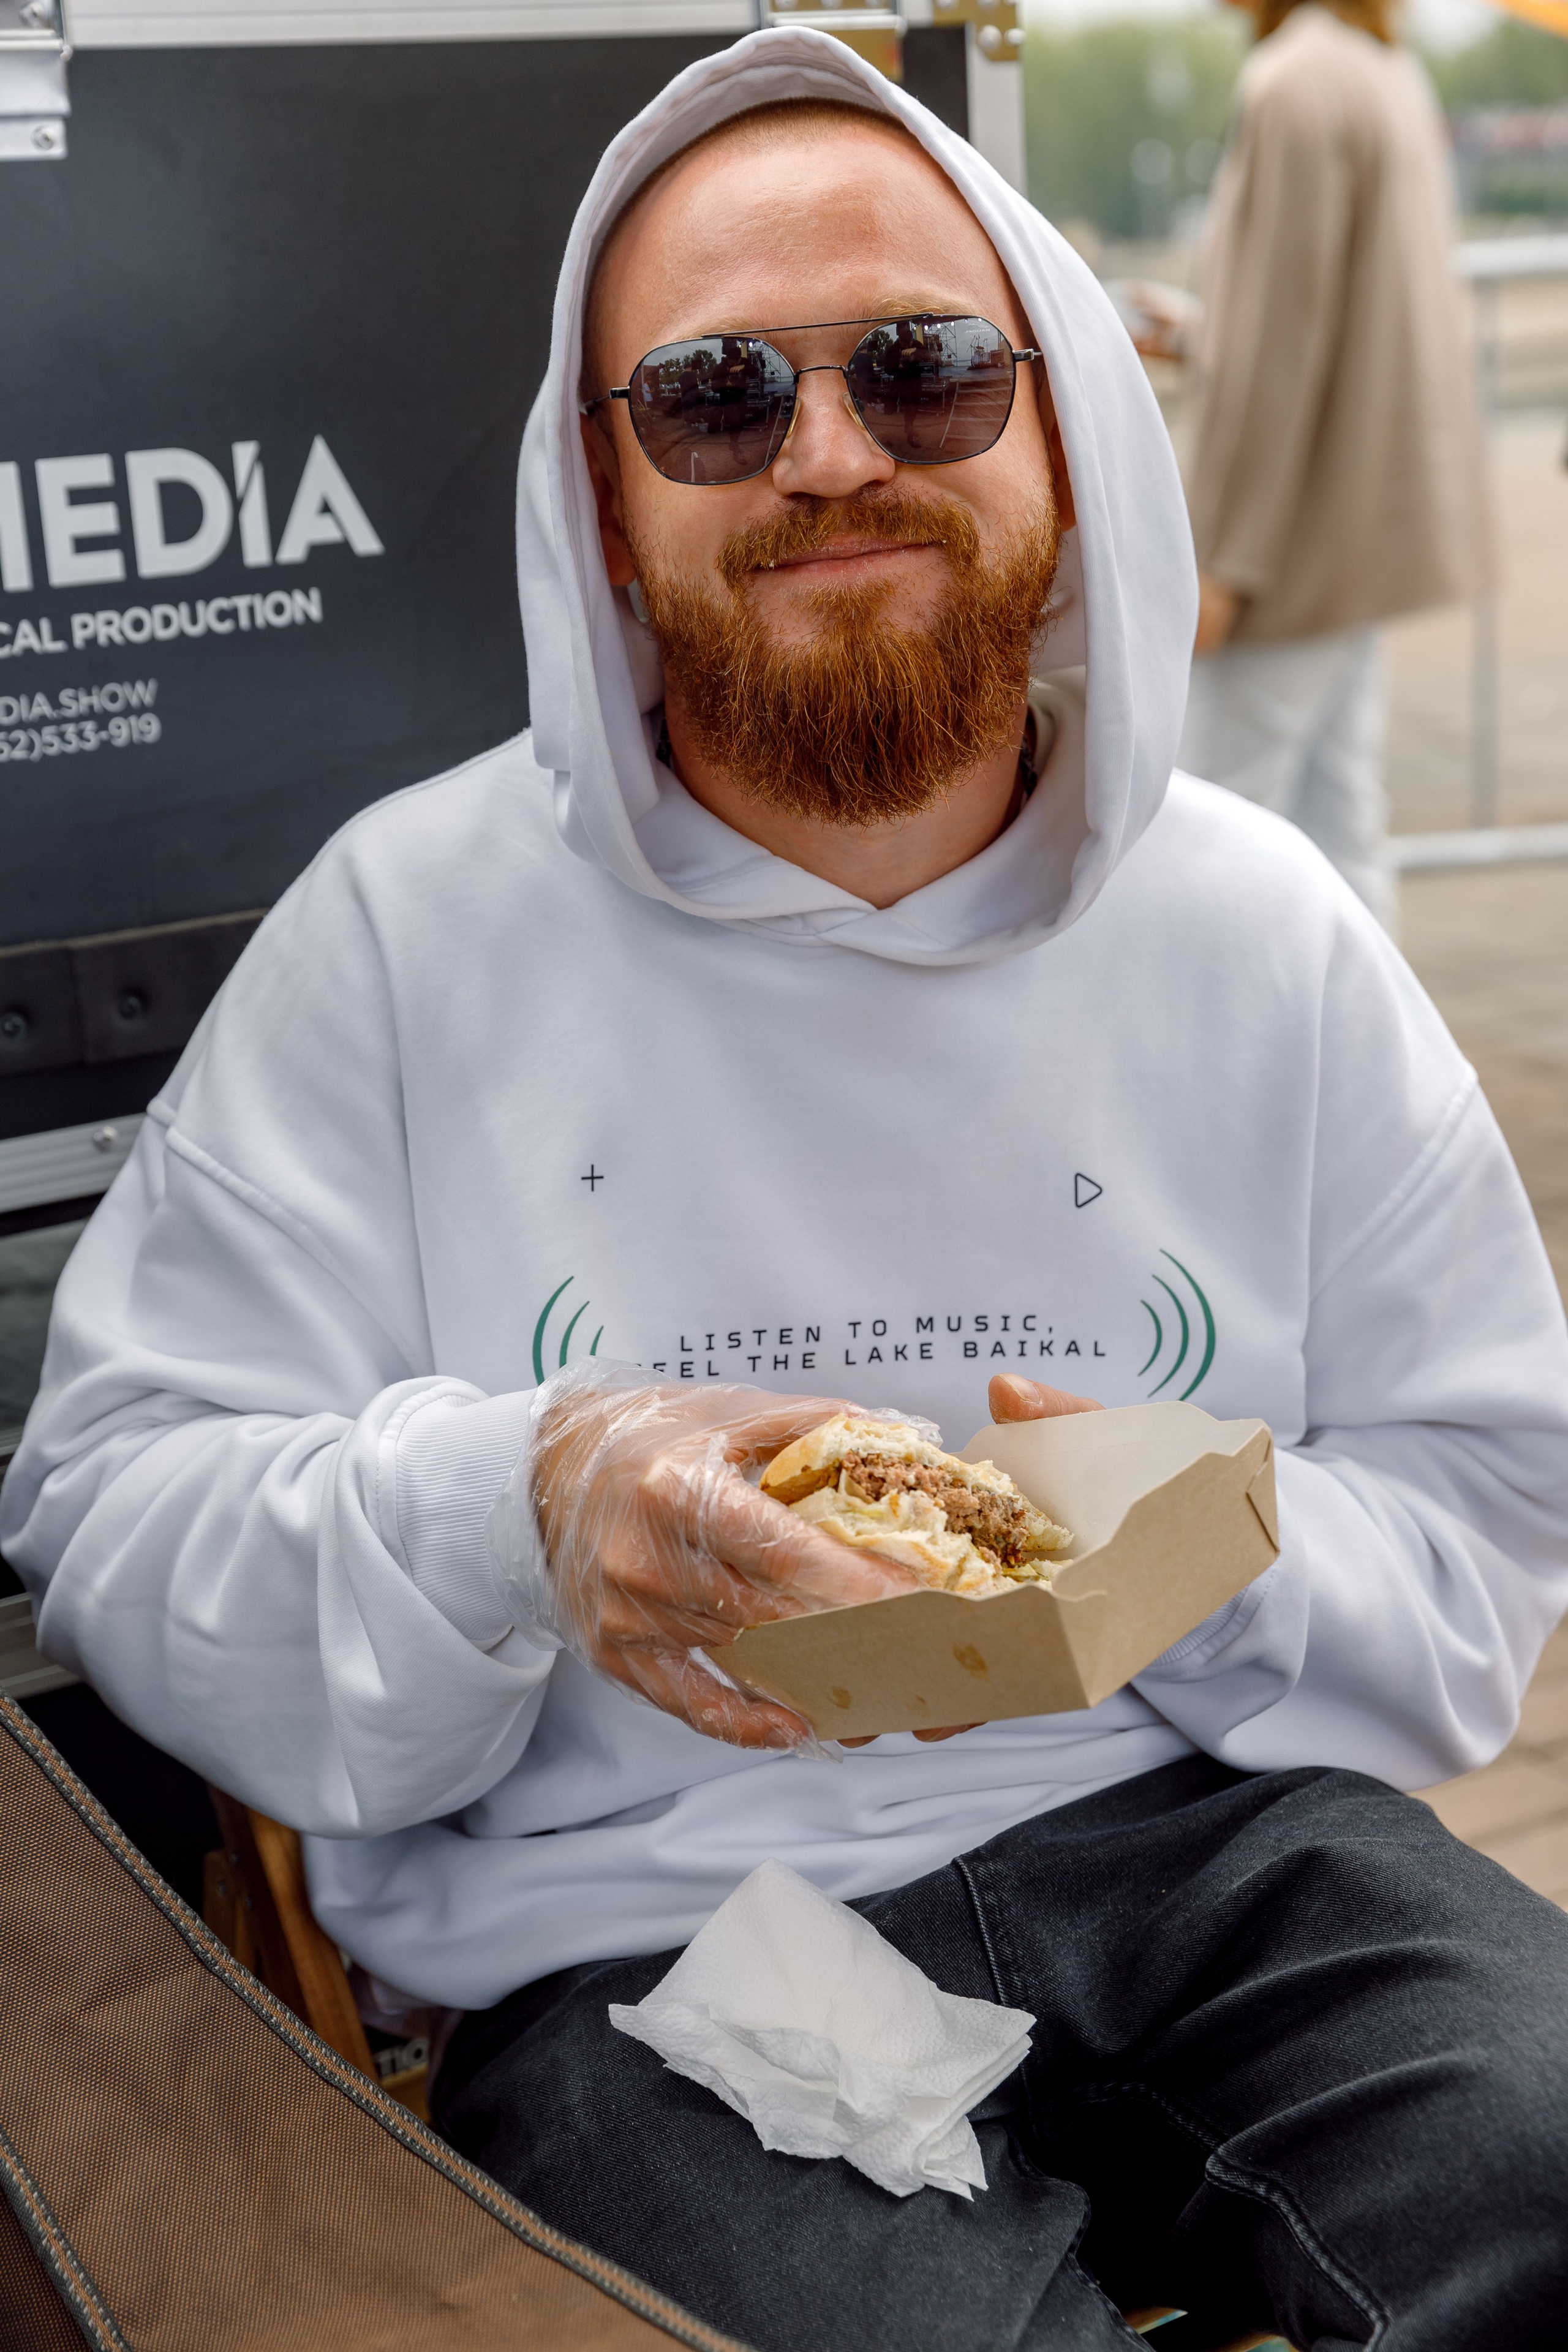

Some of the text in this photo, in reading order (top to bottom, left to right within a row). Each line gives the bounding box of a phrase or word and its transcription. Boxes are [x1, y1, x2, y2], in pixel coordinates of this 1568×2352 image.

[70, 586, 323, 650] PRODUCTION
[680, 1315, 1054, 1352] LISTEN TO MUSIC,
[635, 1340, 1106, 1378] EEL THE LAKE BAIKAL
